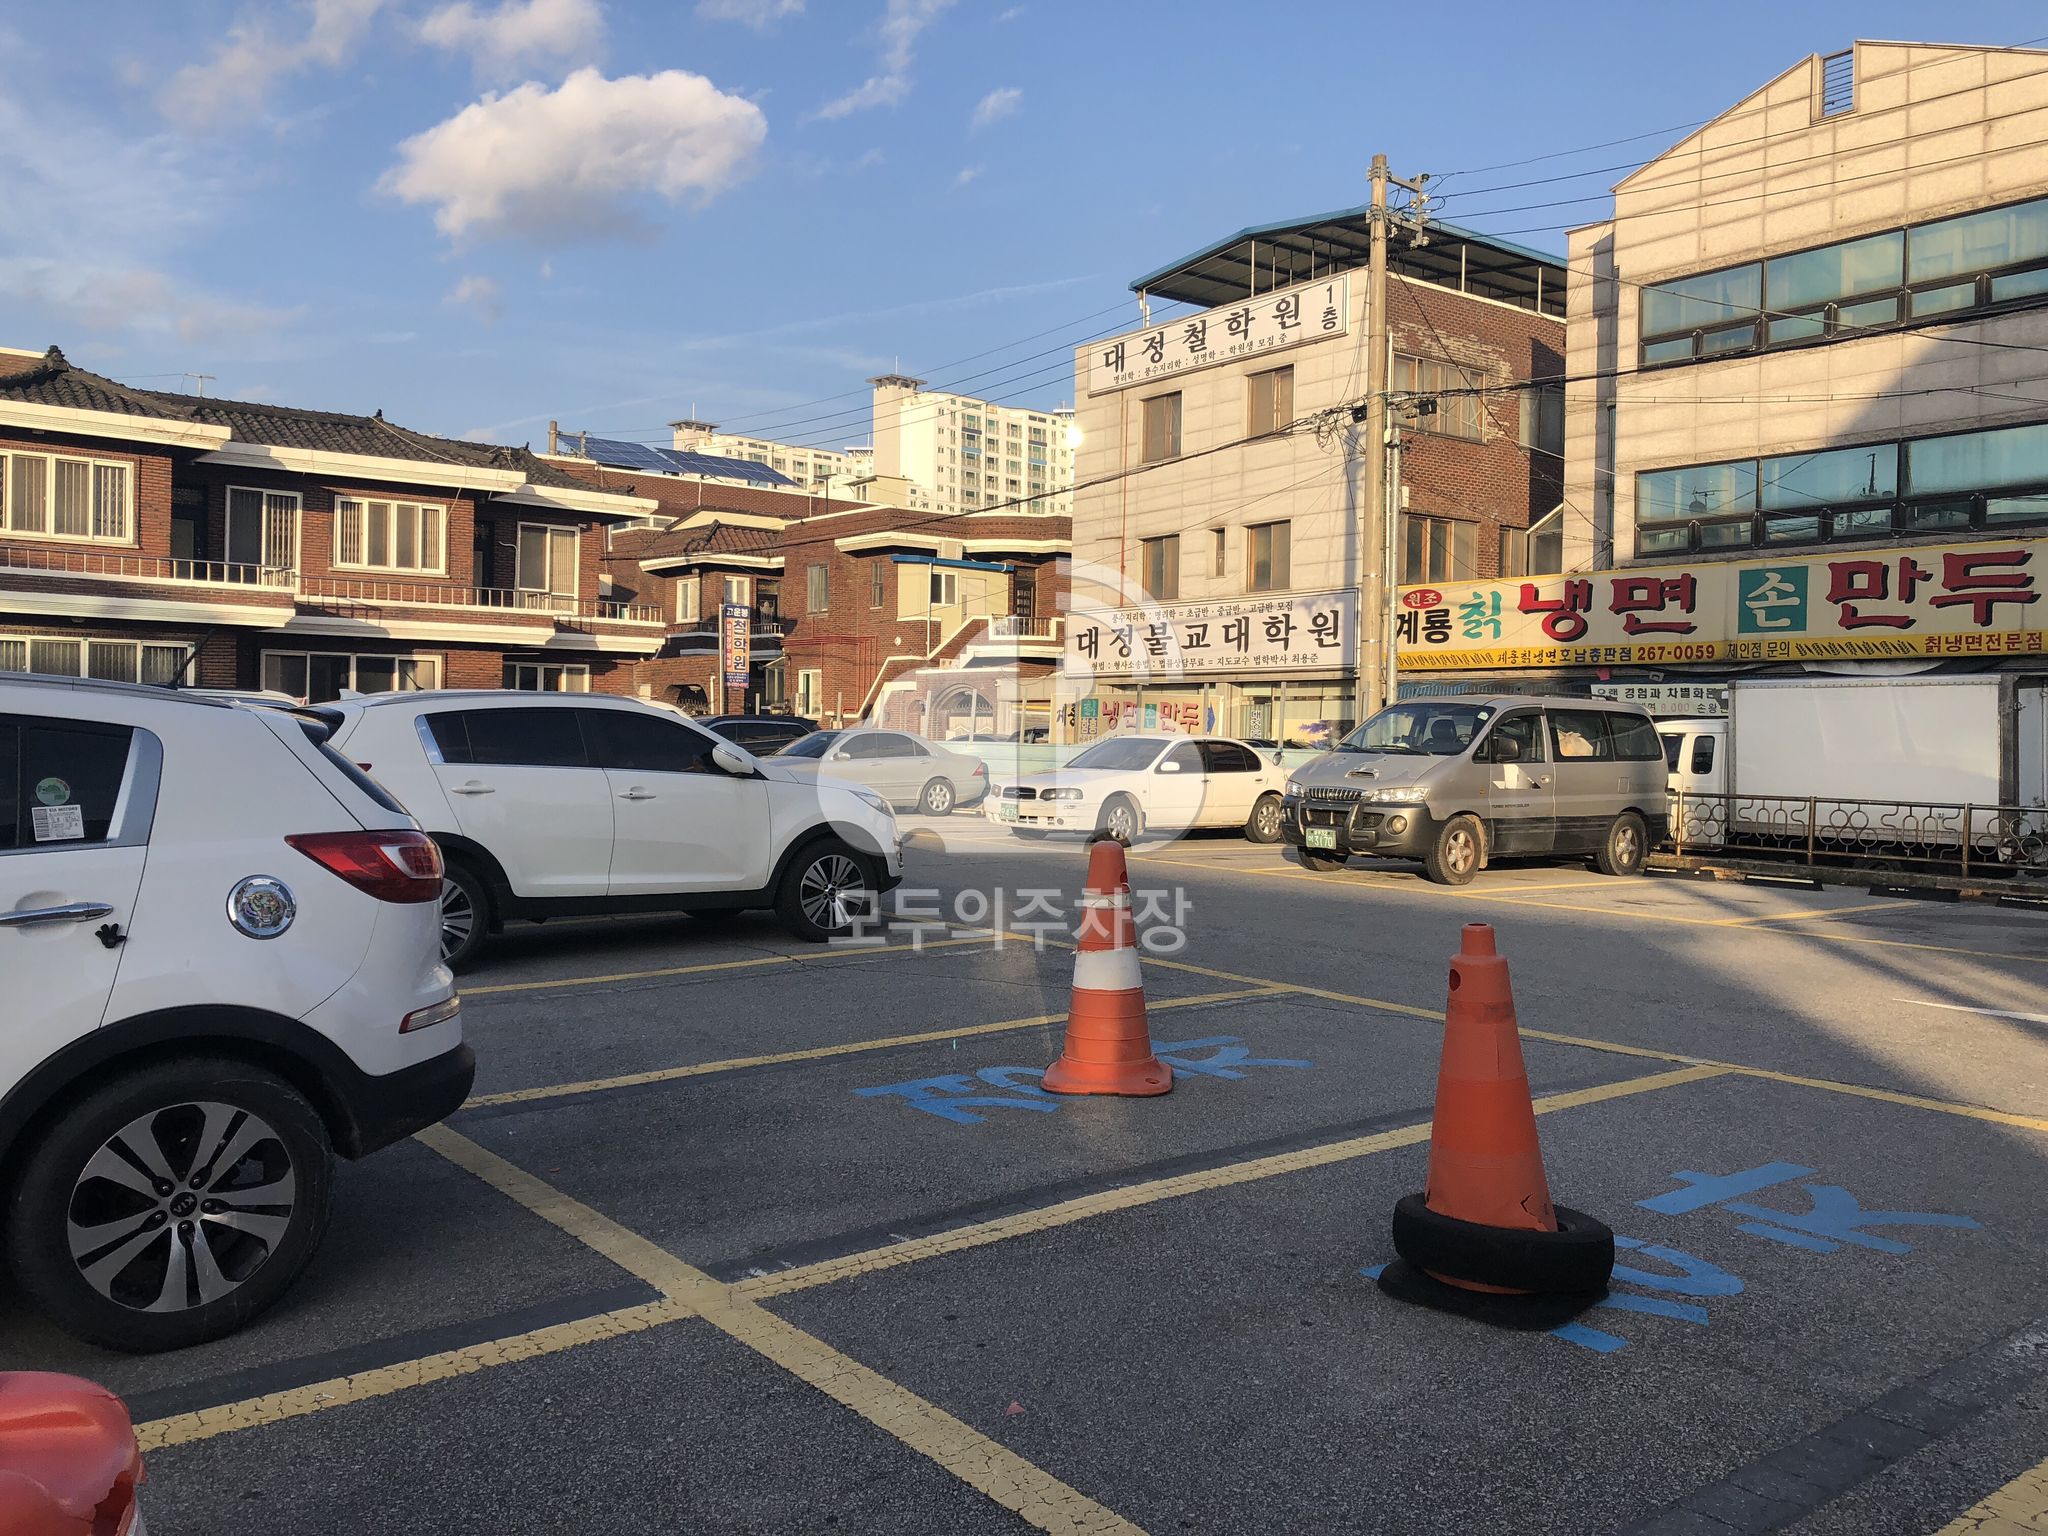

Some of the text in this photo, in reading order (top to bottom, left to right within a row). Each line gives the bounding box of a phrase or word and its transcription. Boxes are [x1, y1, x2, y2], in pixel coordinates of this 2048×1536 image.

[1103, 294, 1300, 373] 대정철학원
[1113, 371, 1134, 384] 명리학
[1144, 359, 1181, 377] 풍수지리학
[1192, 350, 1216, 364] 성명학
[1229, 340, 1254, 355] 학원생
[1258, 335, 1274, 348] 모집
[1112, 600, 1293, 624] 풍수지리학 명리학 초급반 중급반 고급반 모집
[1396, 549, 2042, 644] 계룡 칡 냉면 손 만두
[1407, 593, 1438, 607] 원조
[734, 619, 747, 671] 철학원
[1076, 610, 1341, 659] 대정불교대학원
[1637, 644, 1716, 661] 267-0059
[1727, 642, 1762, 658] 체인점
[1766, 640, 1791, 657] 문의
[1924, 631, 2043, 654] 칡냉면전문점
[1091, 661, 1105, 671] 형법
[1216, 655, 1250, 667] 지도교수
[1253, 653, 1288, 666] 법학박사
[1292, 652, 1319, 664] 최용준
[1624, 687, 1661, 699] 경험과
[1102, 701, 1137, 731] 냉면
[1159, 700, 1200, 734] 만두
